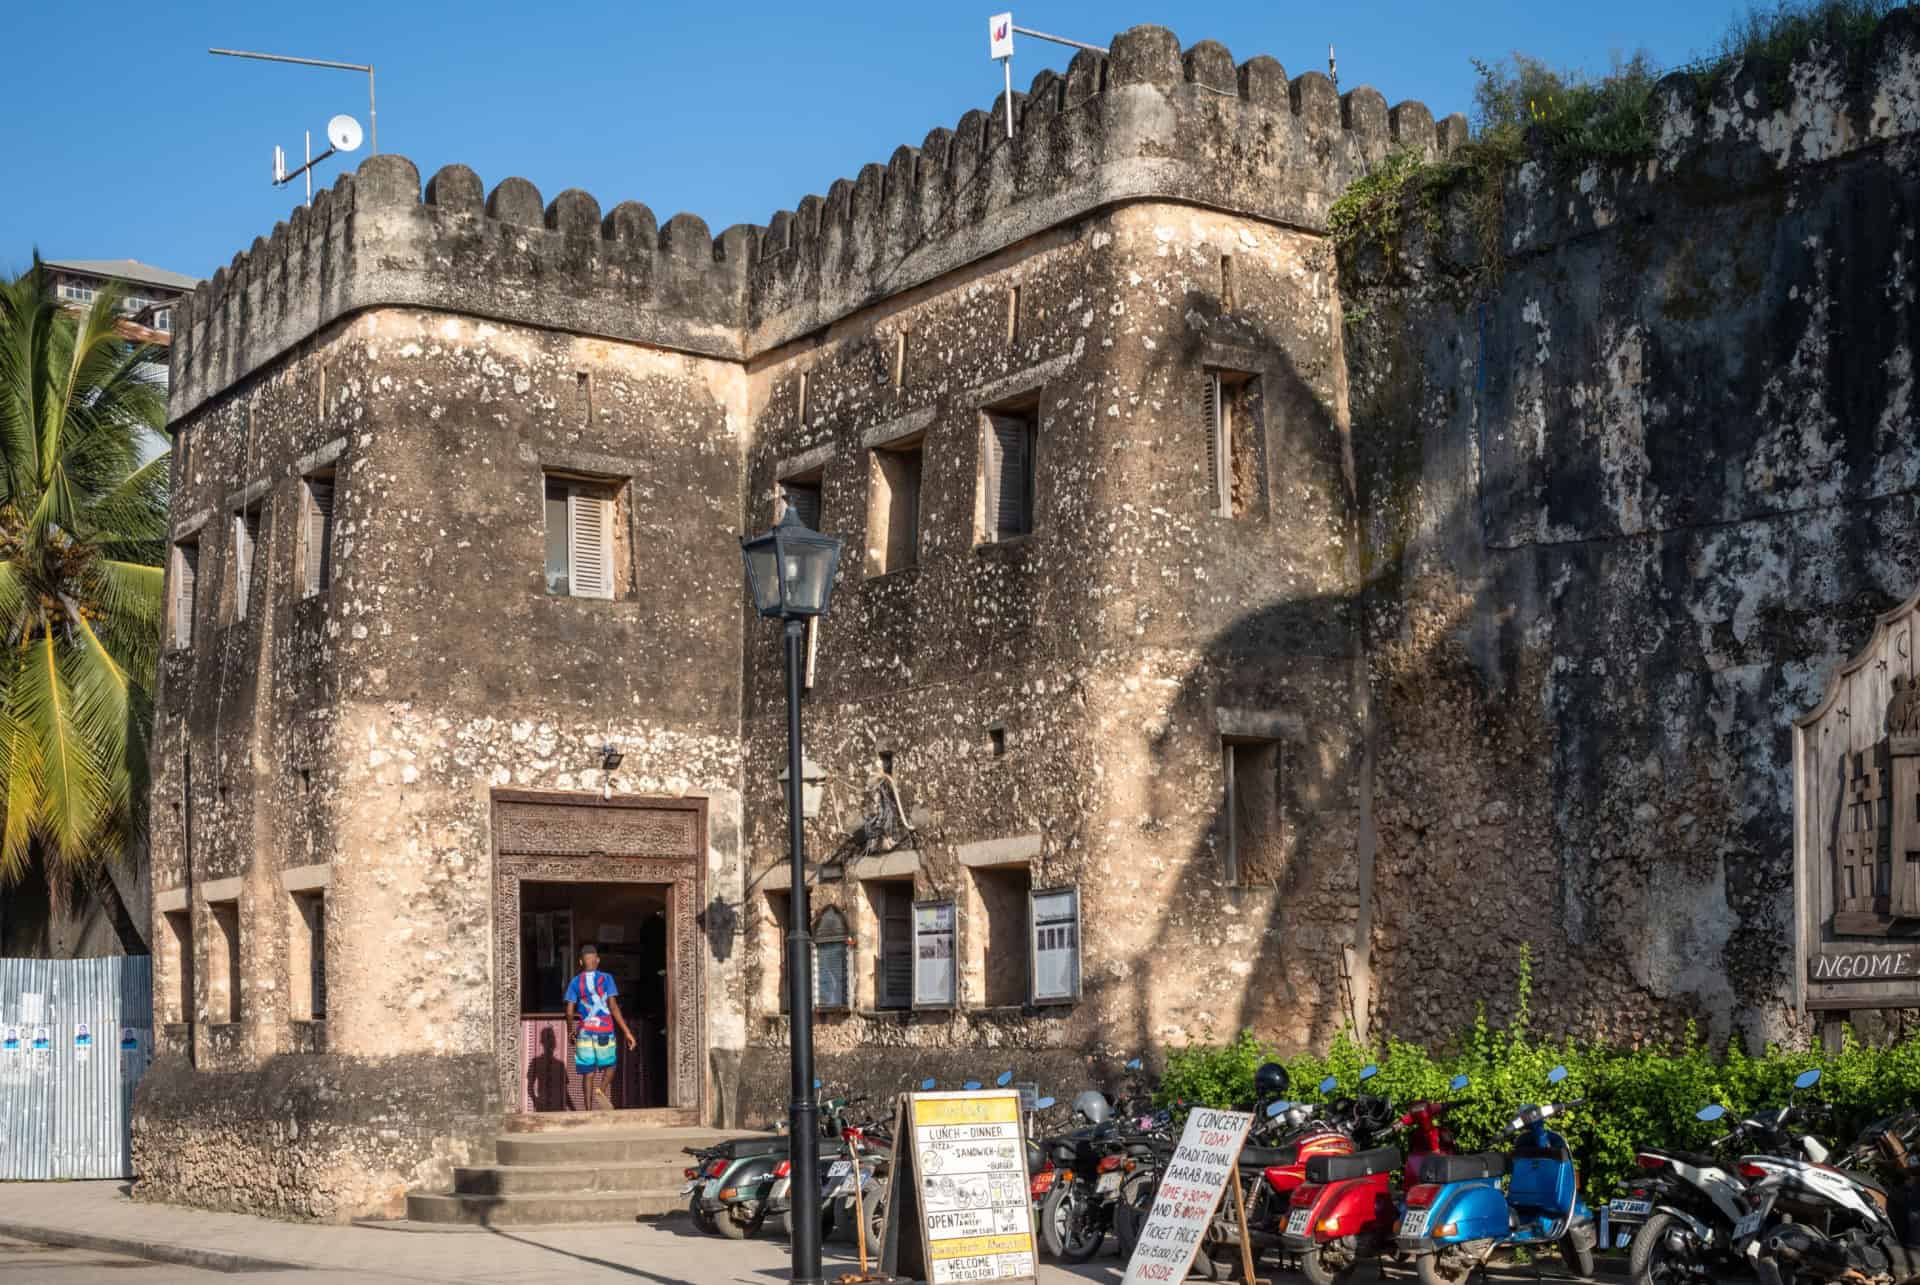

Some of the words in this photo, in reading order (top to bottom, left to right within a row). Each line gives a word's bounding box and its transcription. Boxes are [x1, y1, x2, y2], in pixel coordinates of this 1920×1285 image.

[1815, 952, 1912, 978] NGOME
[1196, 1112, 1248, 1131] CONCERT
[929, 1127, 960, 1140] LUNCH
[970, 1126, 1003, 1137] DINNER
[1199, 1130, 1232, 1147] TODAY
[1177, 1145, 1231, 1167] TRADITIONAL
[1168, 1164, 1202, 1183] TAARAB
[1202, 1171, 1226, 1187] MUSIC
[1160, 1183, 1181, 1200] TIME
[1152, 1202, 1173, 1218] AND
[927, 1213, 954, 1229] OPEN
[1145, 1222, 1175, 1240] TICKET
[1175, 1226, 1200, 1243] PRICE
[948, 1256, 991, 1270] WELCOME
[949, 1270, 962, 1281] THE
[963, 1269, 978, 1280] OLD
[1136, 1263, 1175, 1281] INSIDE
